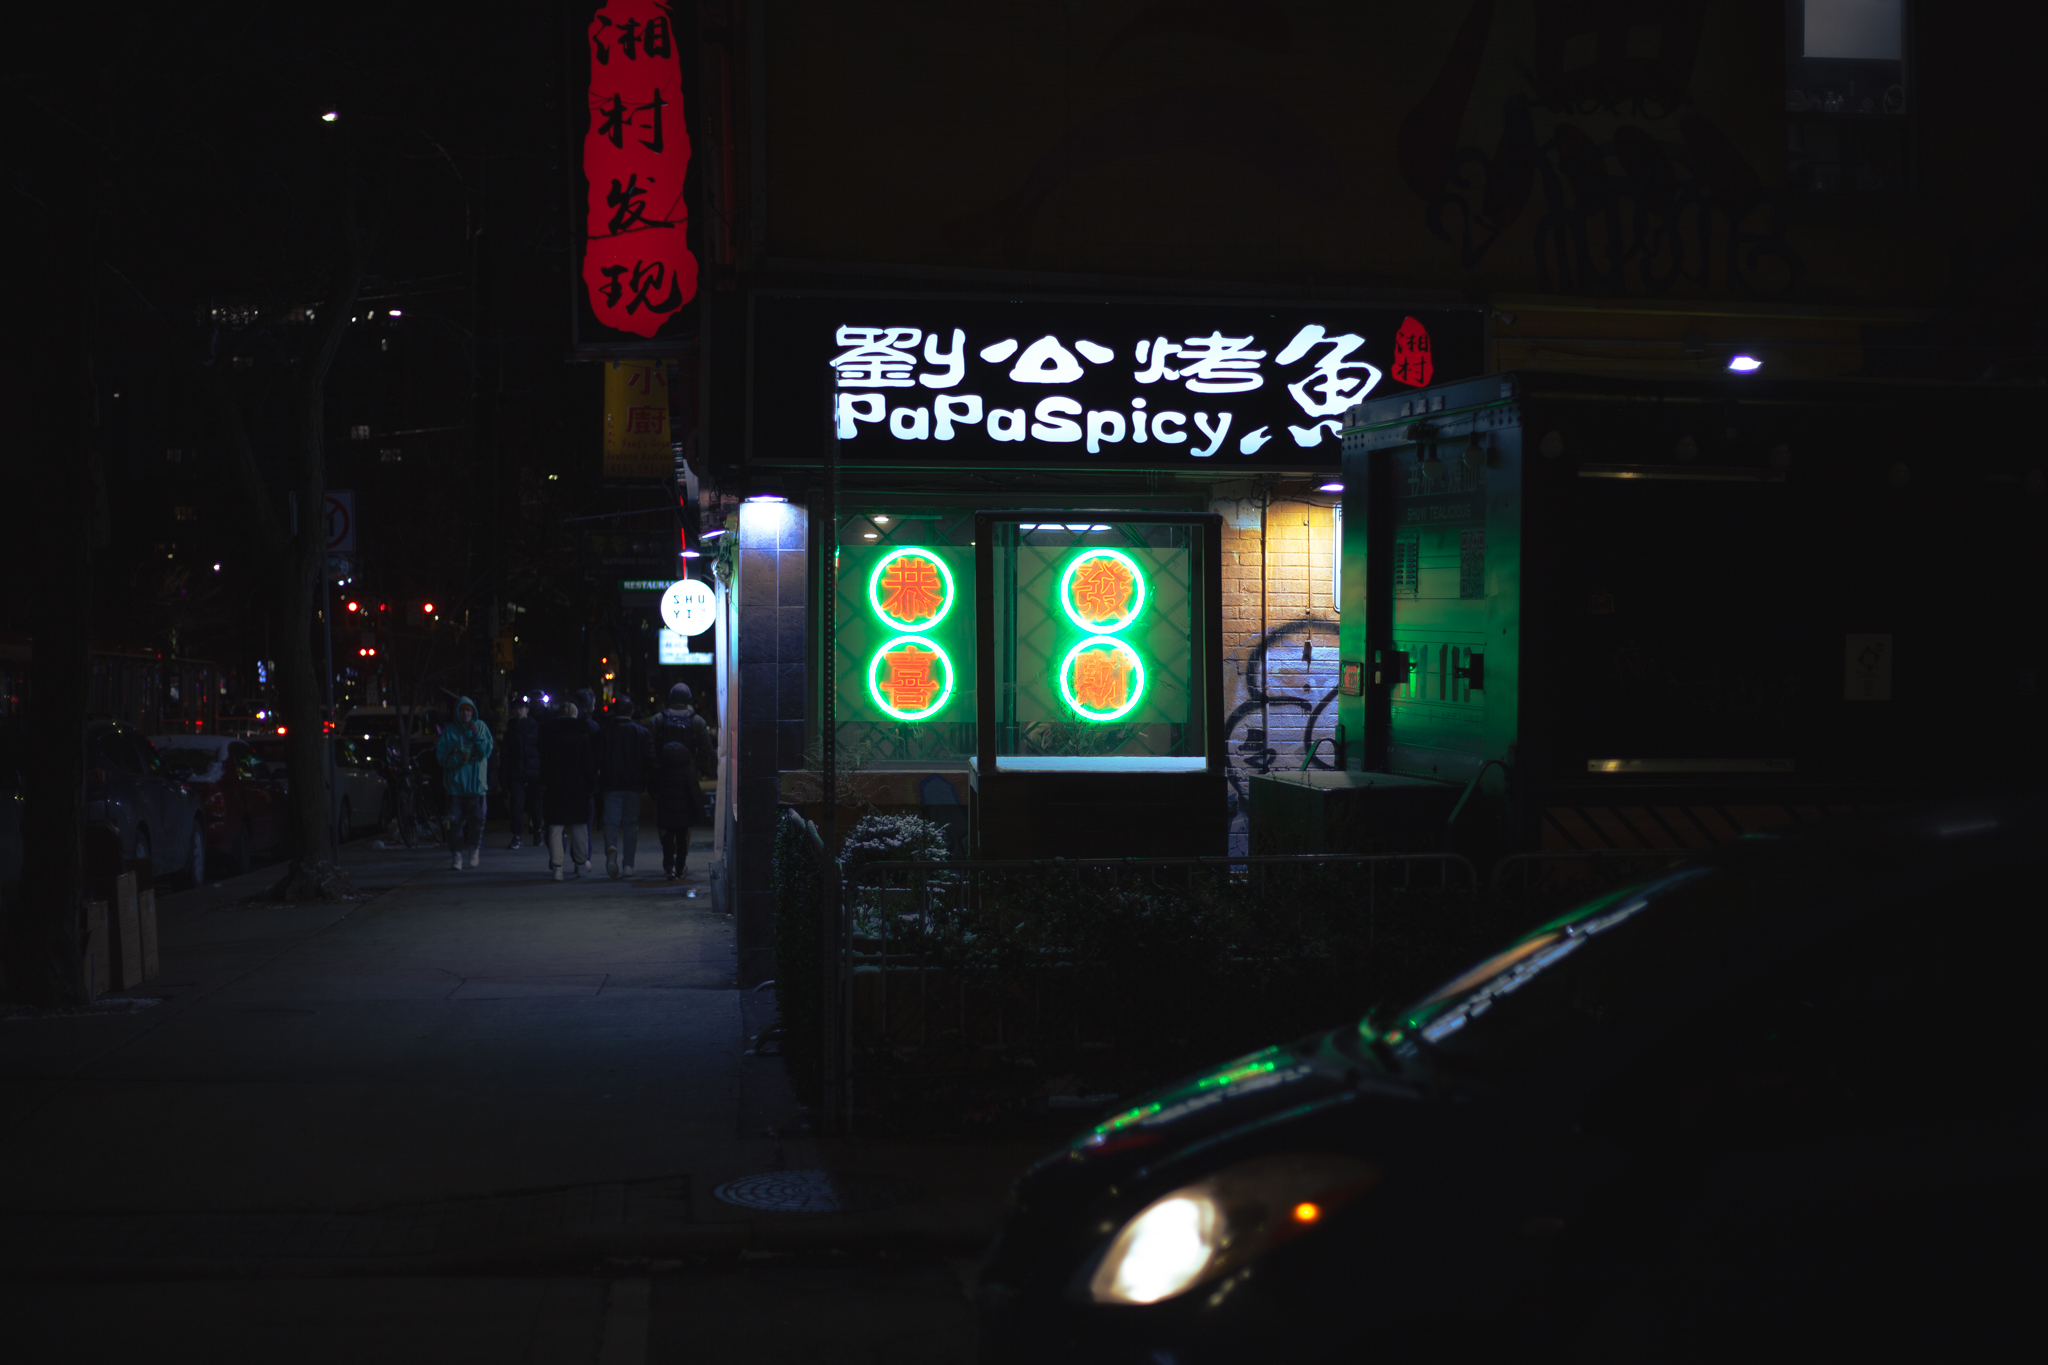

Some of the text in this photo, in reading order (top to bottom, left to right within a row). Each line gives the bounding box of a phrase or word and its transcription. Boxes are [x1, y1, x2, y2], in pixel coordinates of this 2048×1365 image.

[1396, 332, 1429, 385] 湘村
[1407, 503, 1472, 521] SHUYI TEALICIOUS
[673, 594, 705, 605] SHU
[673, 609, 692, 619] YI
[879, 557, 944, 710] 恭喜
